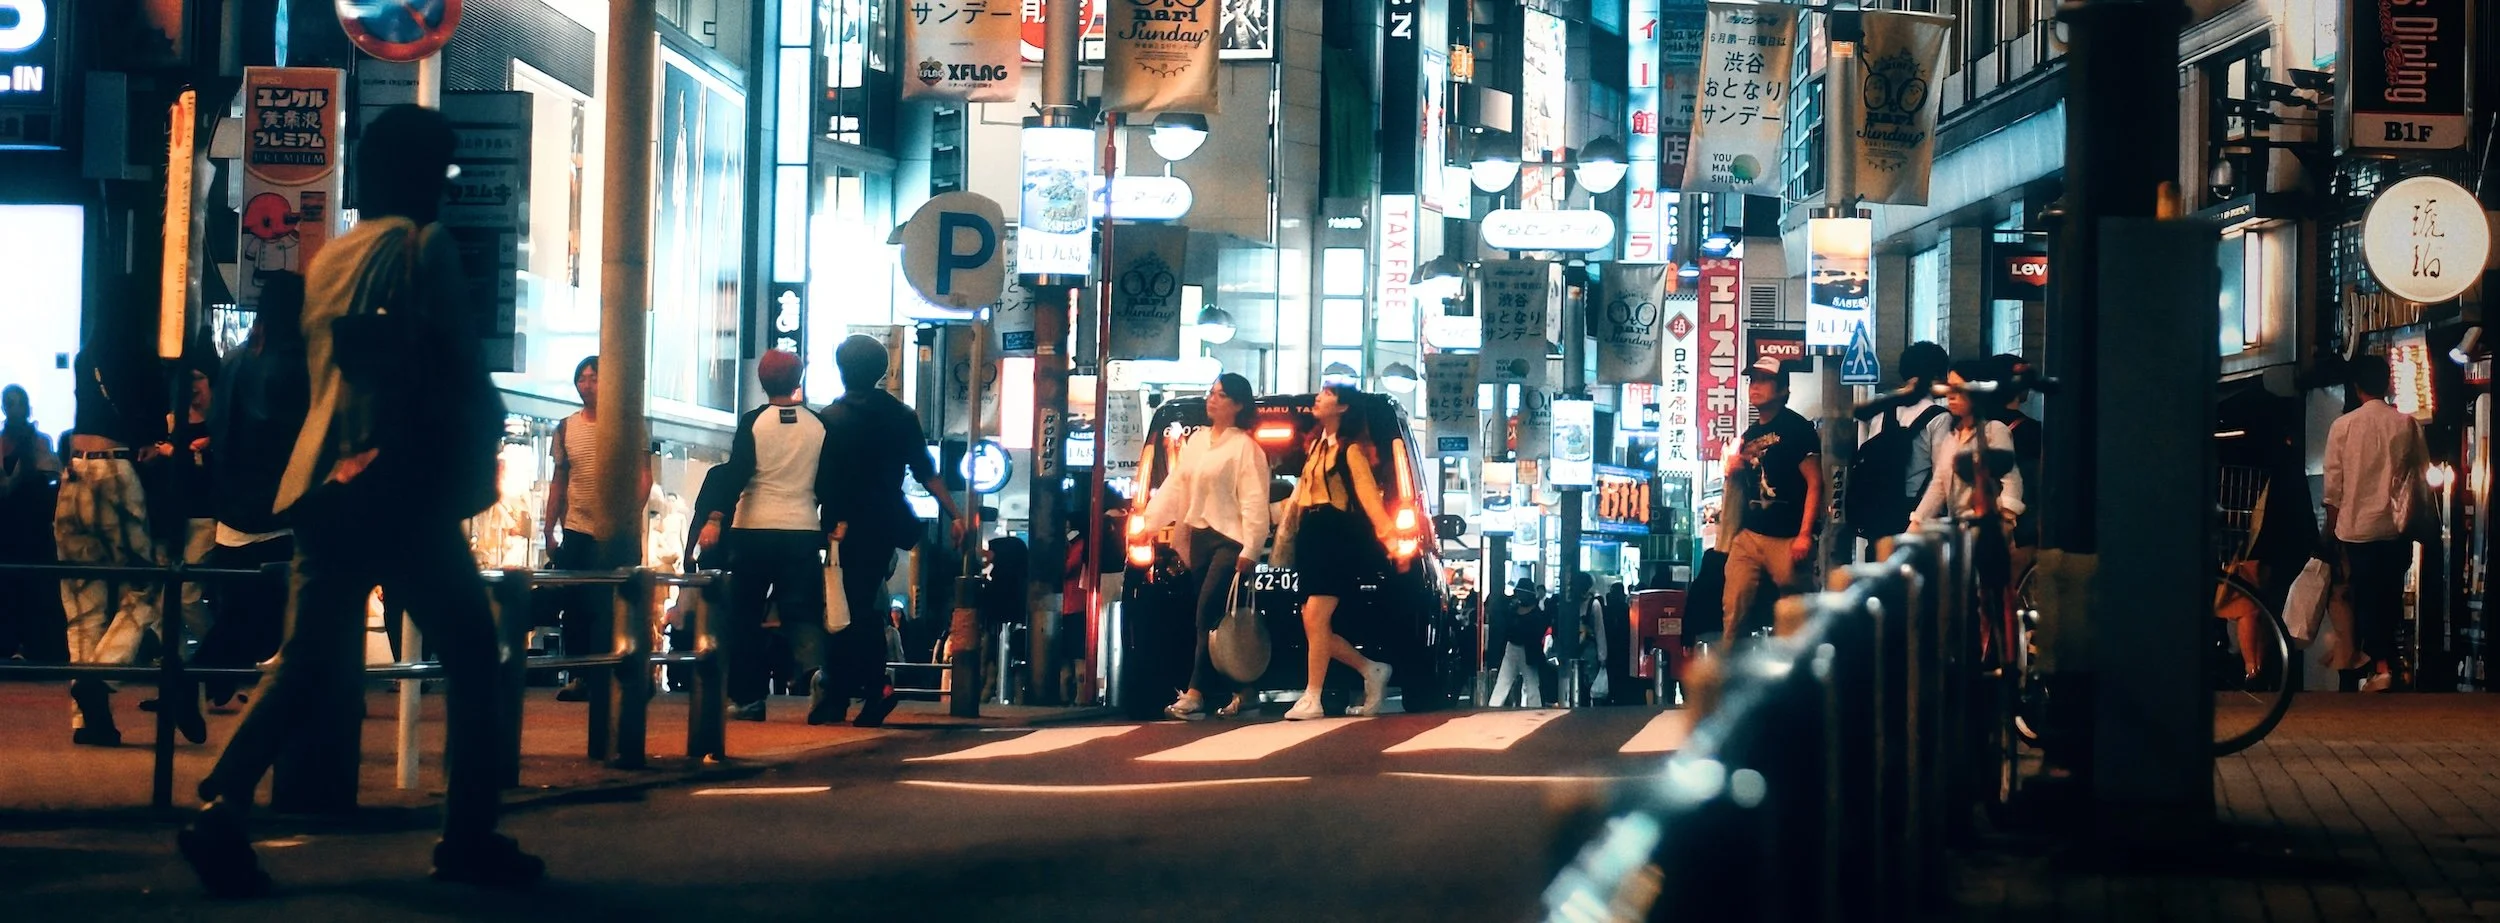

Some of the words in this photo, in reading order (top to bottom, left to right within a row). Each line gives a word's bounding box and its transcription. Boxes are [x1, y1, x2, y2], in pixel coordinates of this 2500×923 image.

[910, 1, 1012, 25] サンデー
[1133, 7, 1198, 22] nari
[1391, 0, 1412, 40] N
[1119, 20, 1209, 49] Sunday
[1724, 51, 1764, 74] 渋谷
[2384, 16, 2438, 103] Dining
[947, 64, 1008, 81] XFLAG
[257, 89, 328, 109] ユンケル
[1704, 77, 1781, 102] おとなり
[1701, 104, 1780, 126] サンデー
[2384, 121, 2433, 143] B1F
[1712, 163, 1735, 172] MAK
[1713, 153, 1732, 162] YOU
[1387, 210, 1408, 250] TAX
[936, 211, 997, 295] P
[1385, 259, 1408, 308] FREE
[1498, 292, 1529, 308] 渋谷
[1485, 310, 1541, 326] おとなり
[1485, 327, 1541, 341] サンデー
[1706, 275, 1737, 445] エクステ市場
